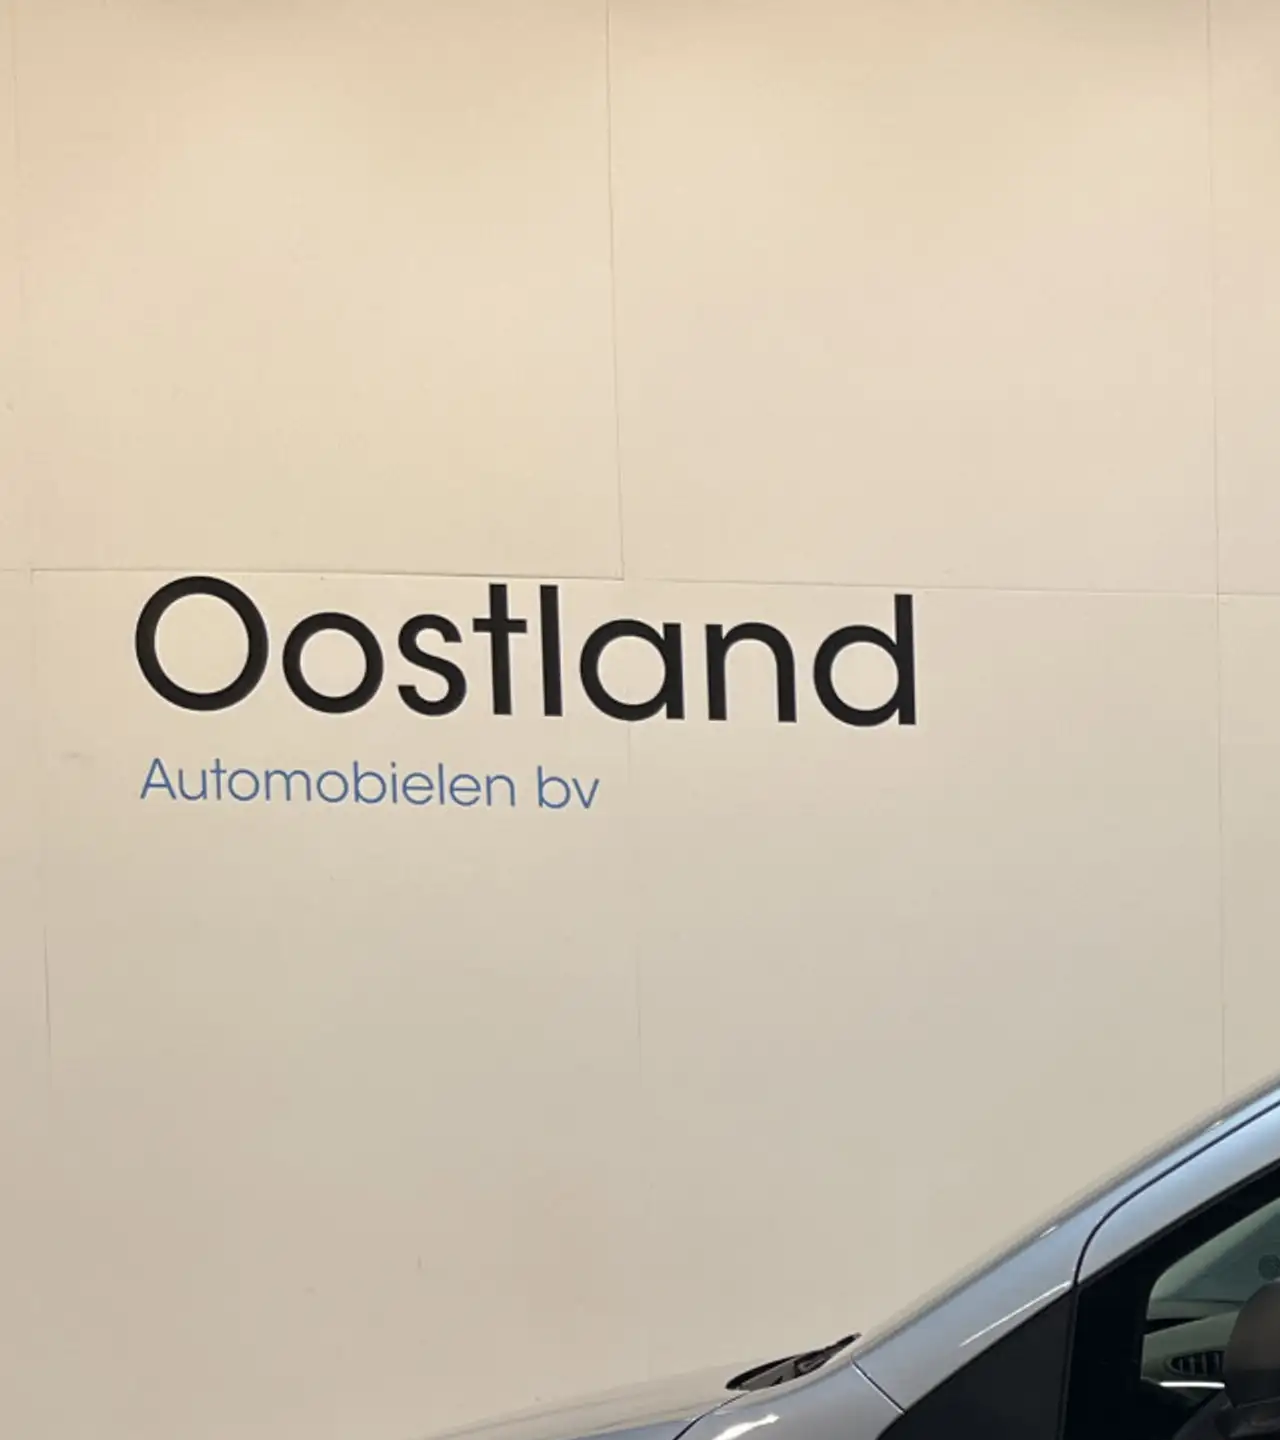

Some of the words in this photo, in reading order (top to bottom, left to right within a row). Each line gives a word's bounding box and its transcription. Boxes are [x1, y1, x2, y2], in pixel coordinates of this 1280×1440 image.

[136, 577, 916, 727] Oostland
[140, 757, 517, 807] Automobielen
[537, 766, 600, 810] bv
